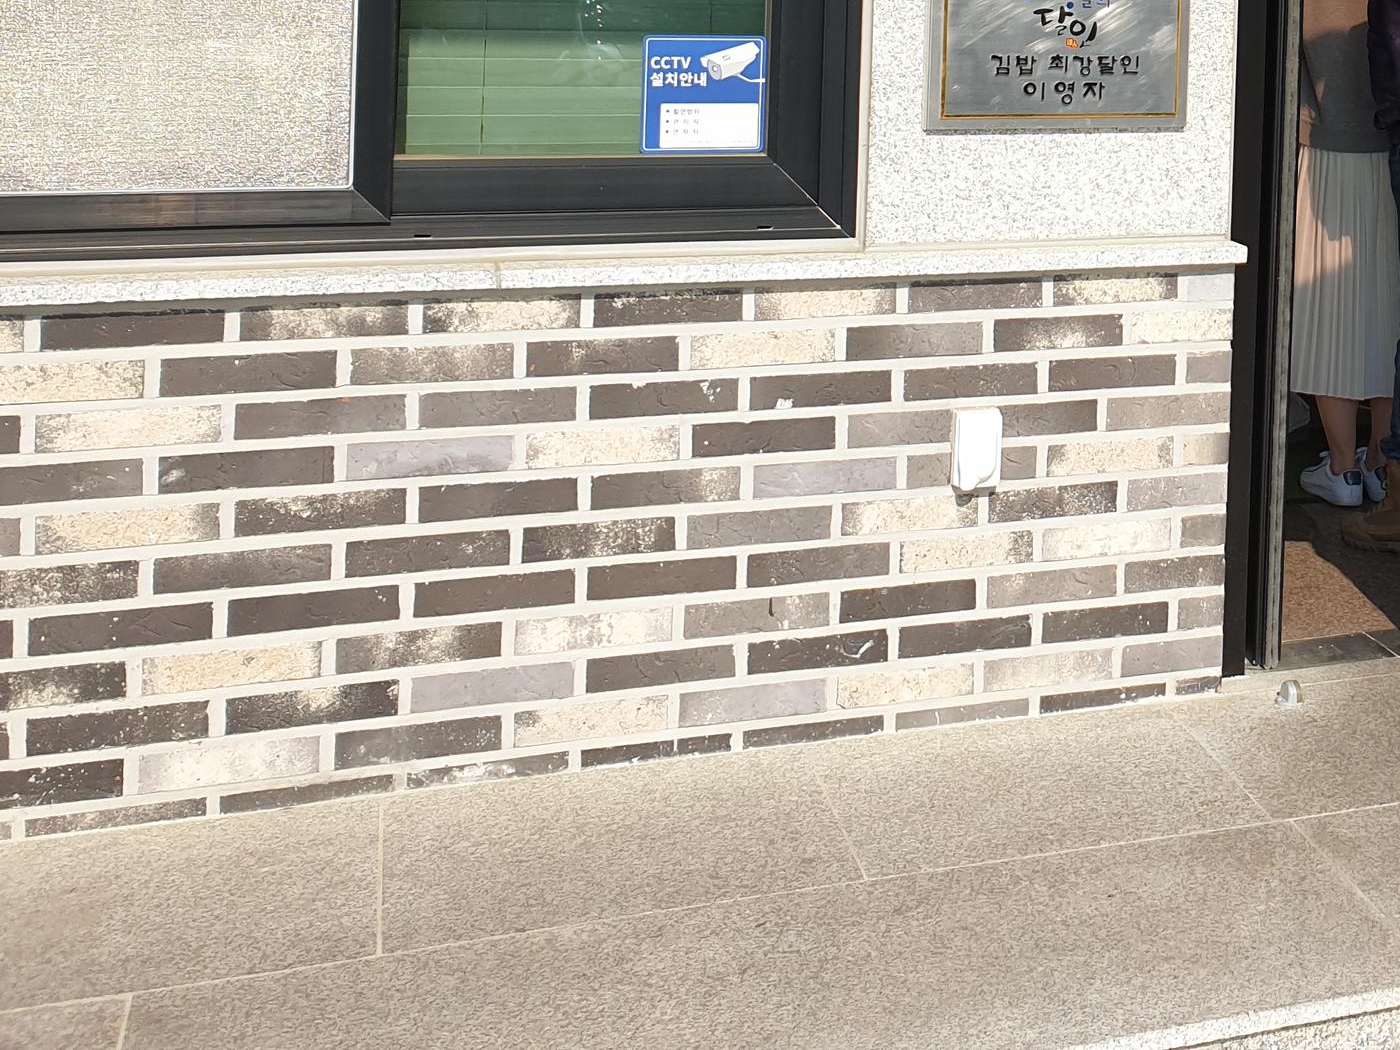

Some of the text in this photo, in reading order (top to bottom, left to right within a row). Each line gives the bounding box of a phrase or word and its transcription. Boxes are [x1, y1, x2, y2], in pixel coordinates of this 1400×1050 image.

[1033, 5, 1097, 49] 달인
[650, 56, 691, 69] CCTV
[991, 54, 1037, 77] 김밥
[650, 71, 707, 87] 설치안내
